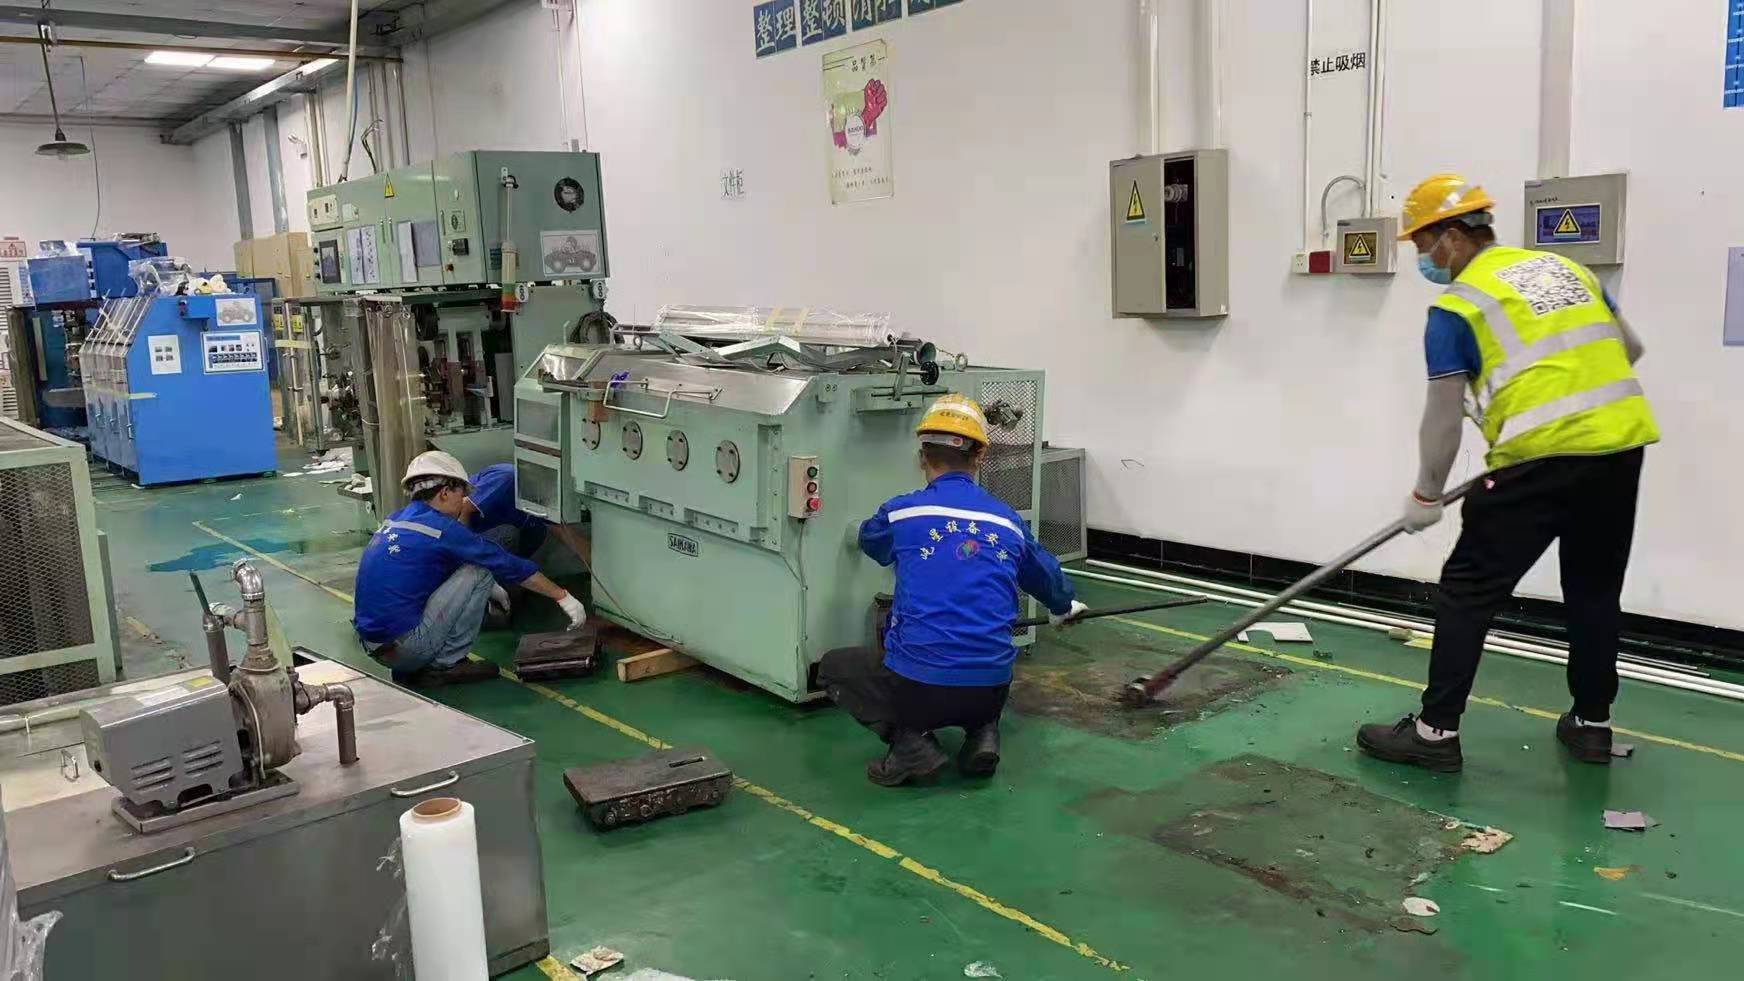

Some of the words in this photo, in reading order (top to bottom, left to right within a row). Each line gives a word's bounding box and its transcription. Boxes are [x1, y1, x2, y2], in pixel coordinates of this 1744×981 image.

[757, 7, 797, 52] 整理
[1310, 52, 1366, 76] 禁止吸烟
